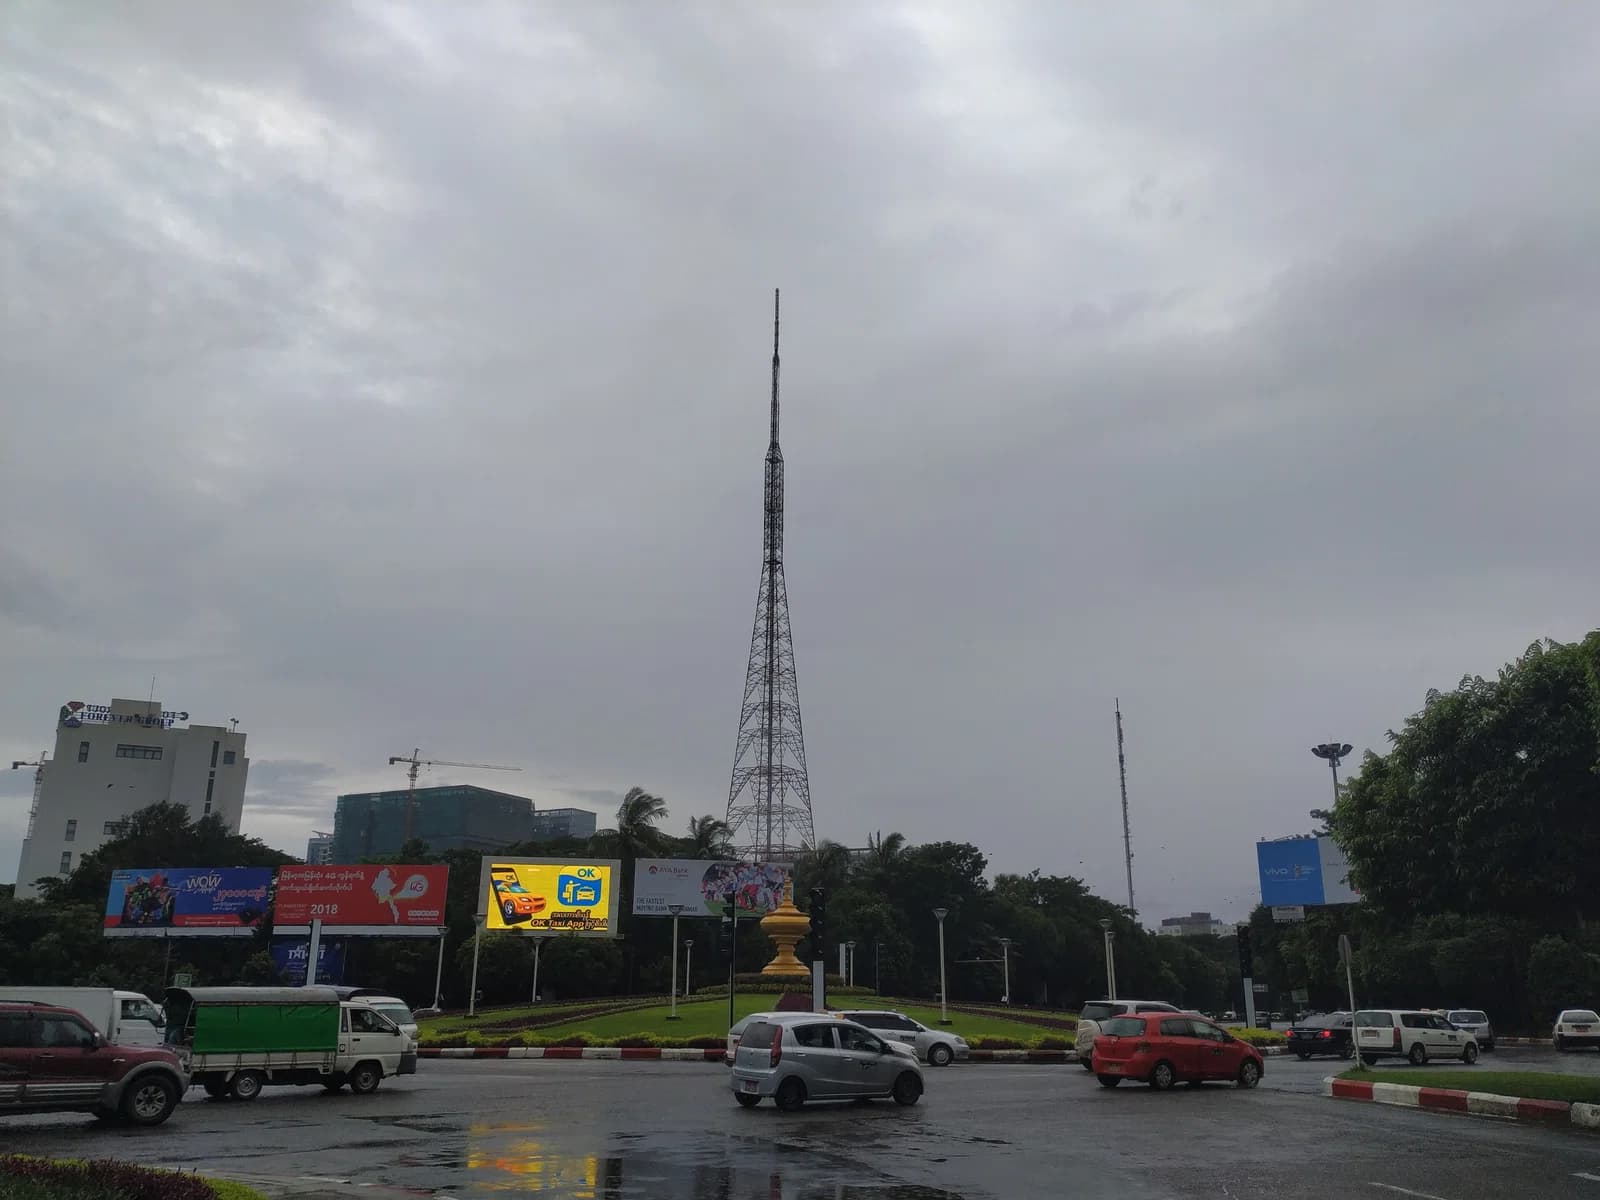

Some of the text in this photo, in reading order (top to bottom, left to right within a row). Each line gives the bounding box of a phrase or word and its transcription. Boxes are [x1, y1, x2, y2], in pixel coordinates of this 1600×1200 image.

[80, 712, 133, 723] FOREVER
[577, 868, 595, 878] OK
[310, 904, 339, 914] 2018
[567, 920, 584, 929] App
